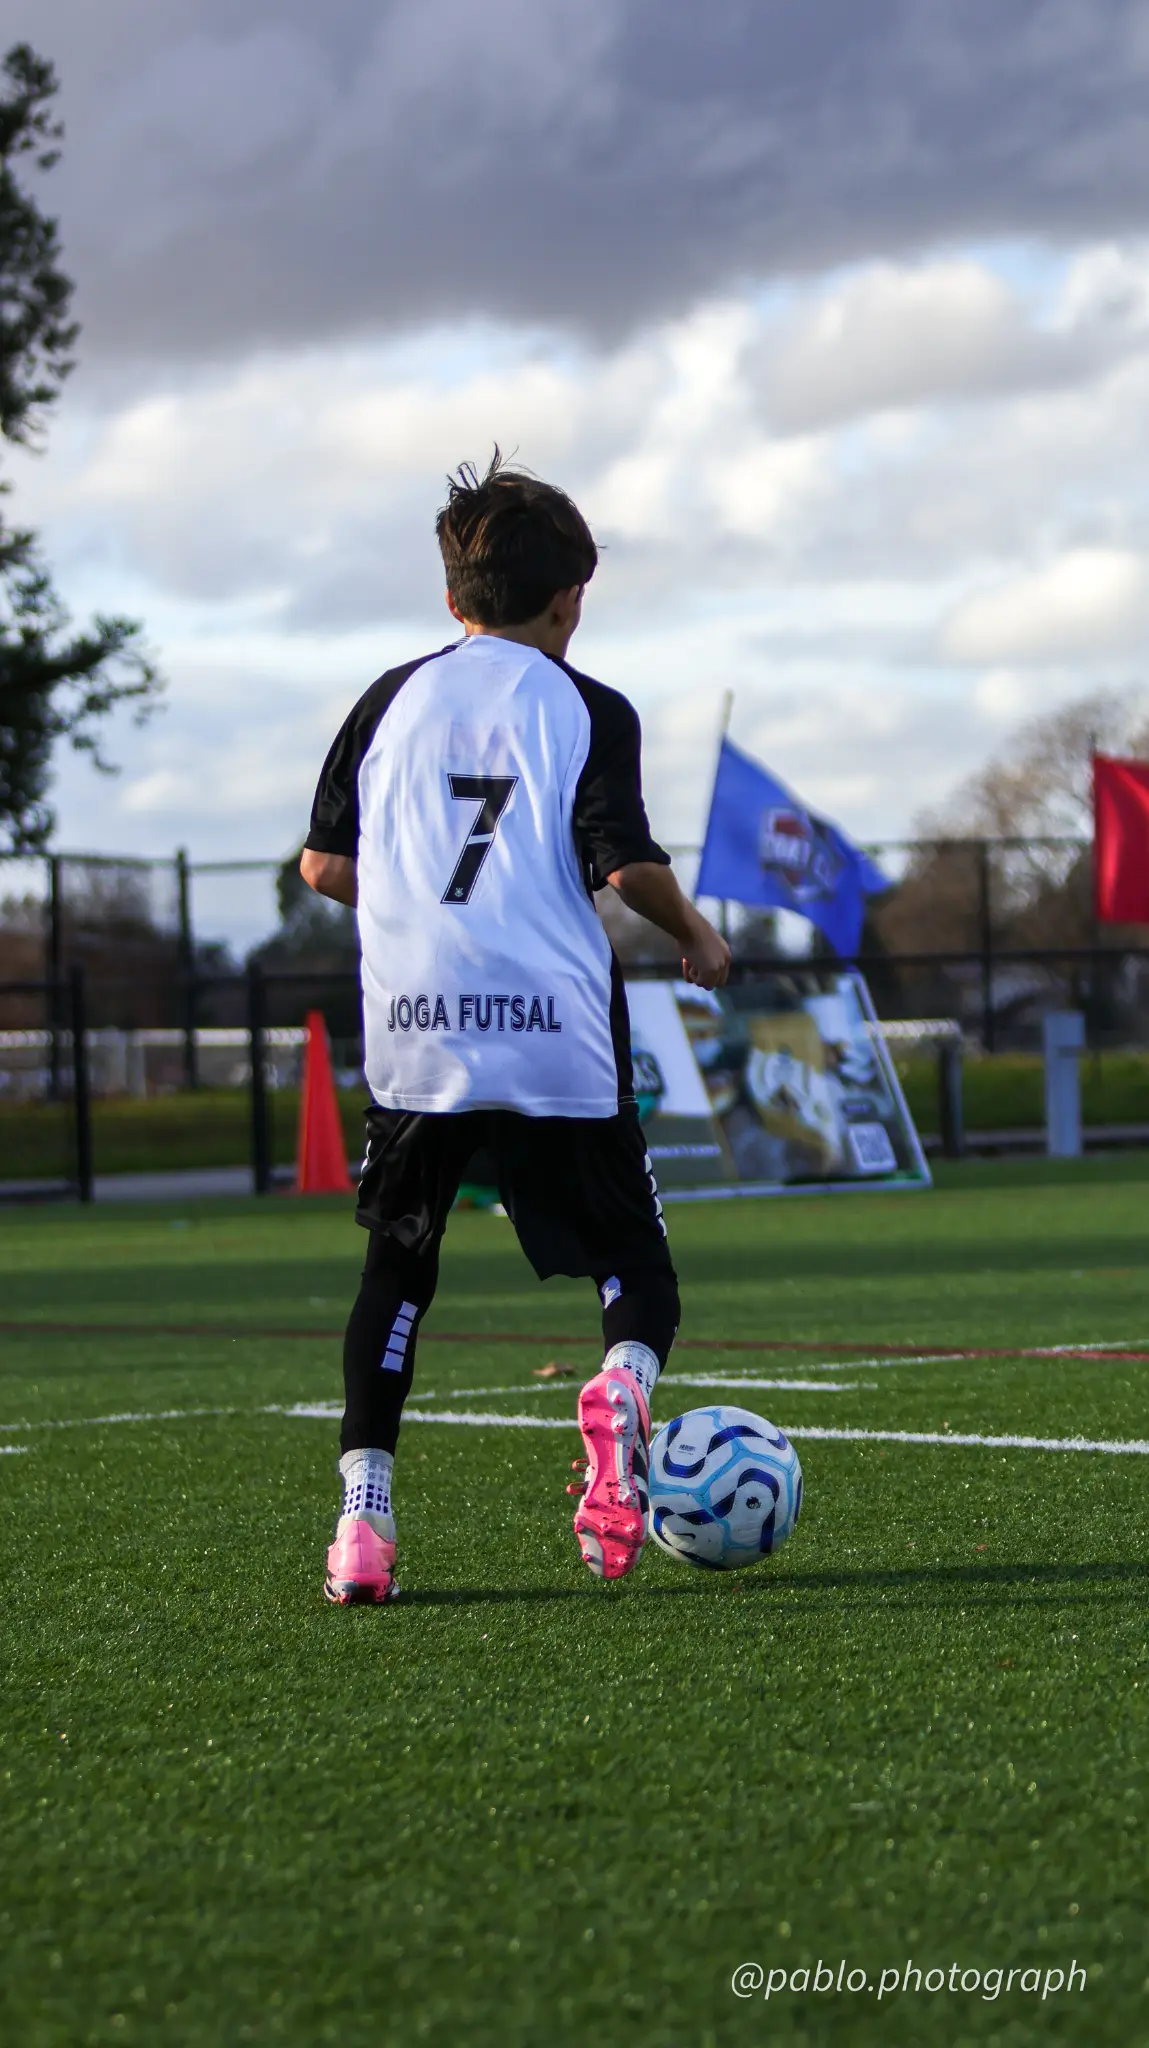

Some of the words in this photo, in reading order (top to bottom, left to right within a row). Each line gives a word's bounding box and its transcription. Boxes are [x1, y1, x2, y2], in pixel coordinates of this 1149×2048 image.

[440, 773, 519, 905] 7
[387, 994, 451, 1032] JOGA
[459, 994, 562, 1033] FUTSAL
